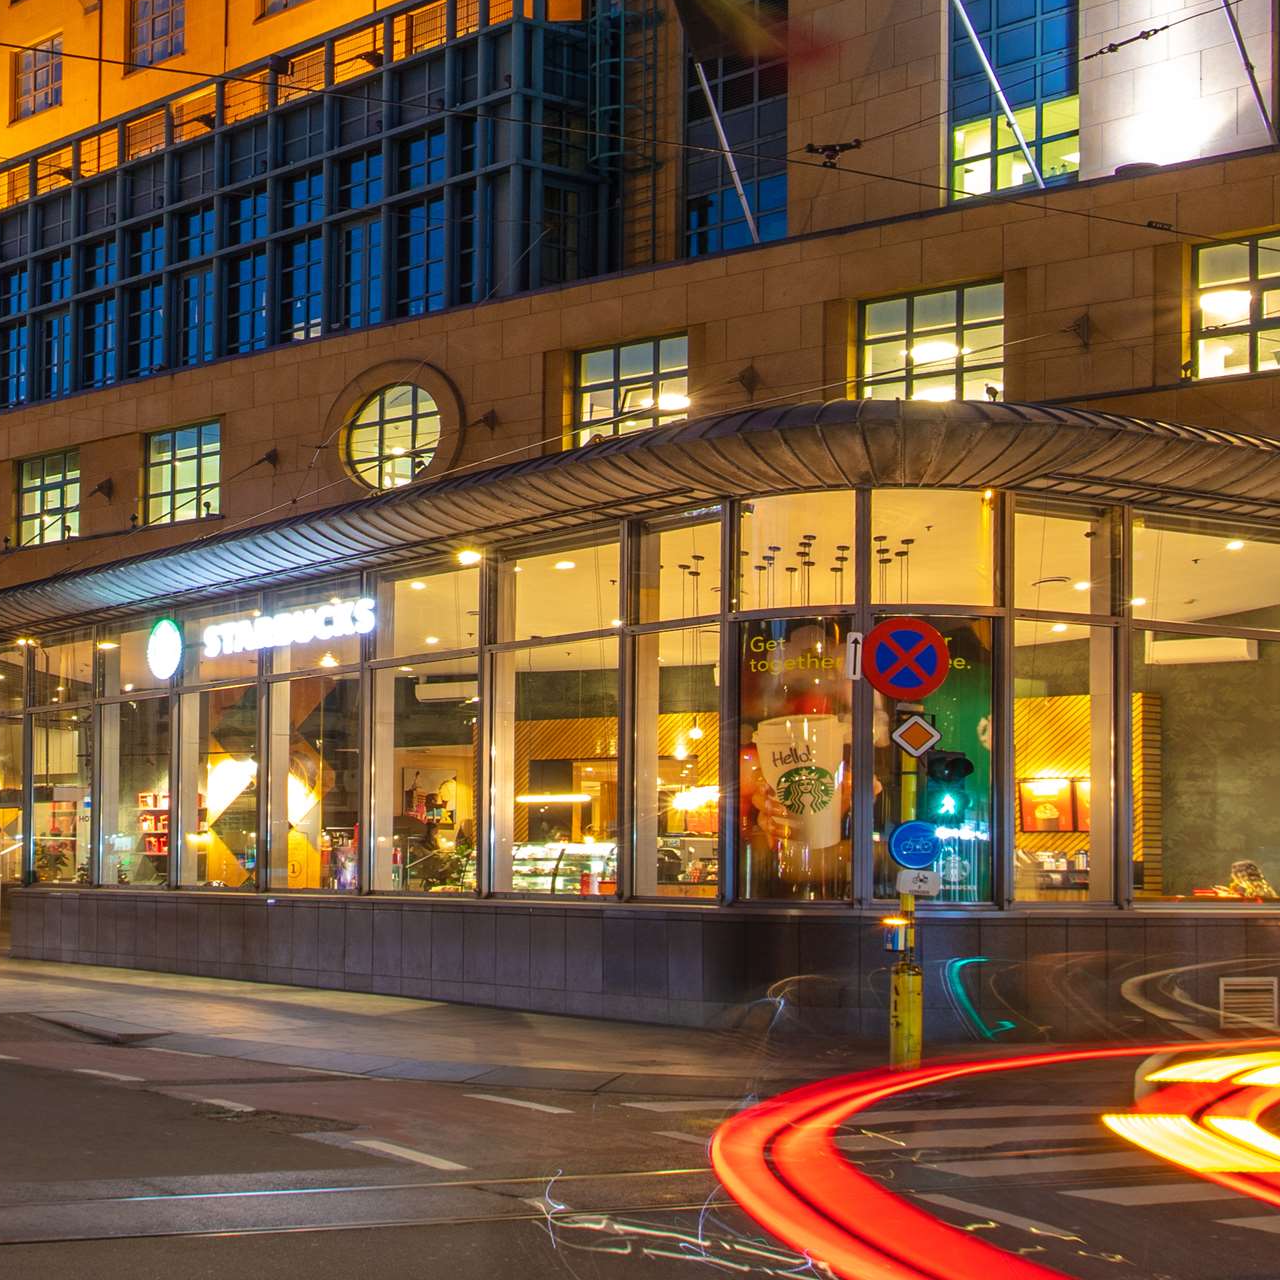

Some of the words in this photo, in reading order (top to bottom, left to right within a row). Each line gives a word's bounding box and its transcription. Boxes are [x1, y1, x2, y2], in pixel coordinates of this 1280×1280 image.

[203, 597, 376, 658] STARBUCKS
[750, 637, 785, 653] Get
[771, 745, 812, 768] Hello!
